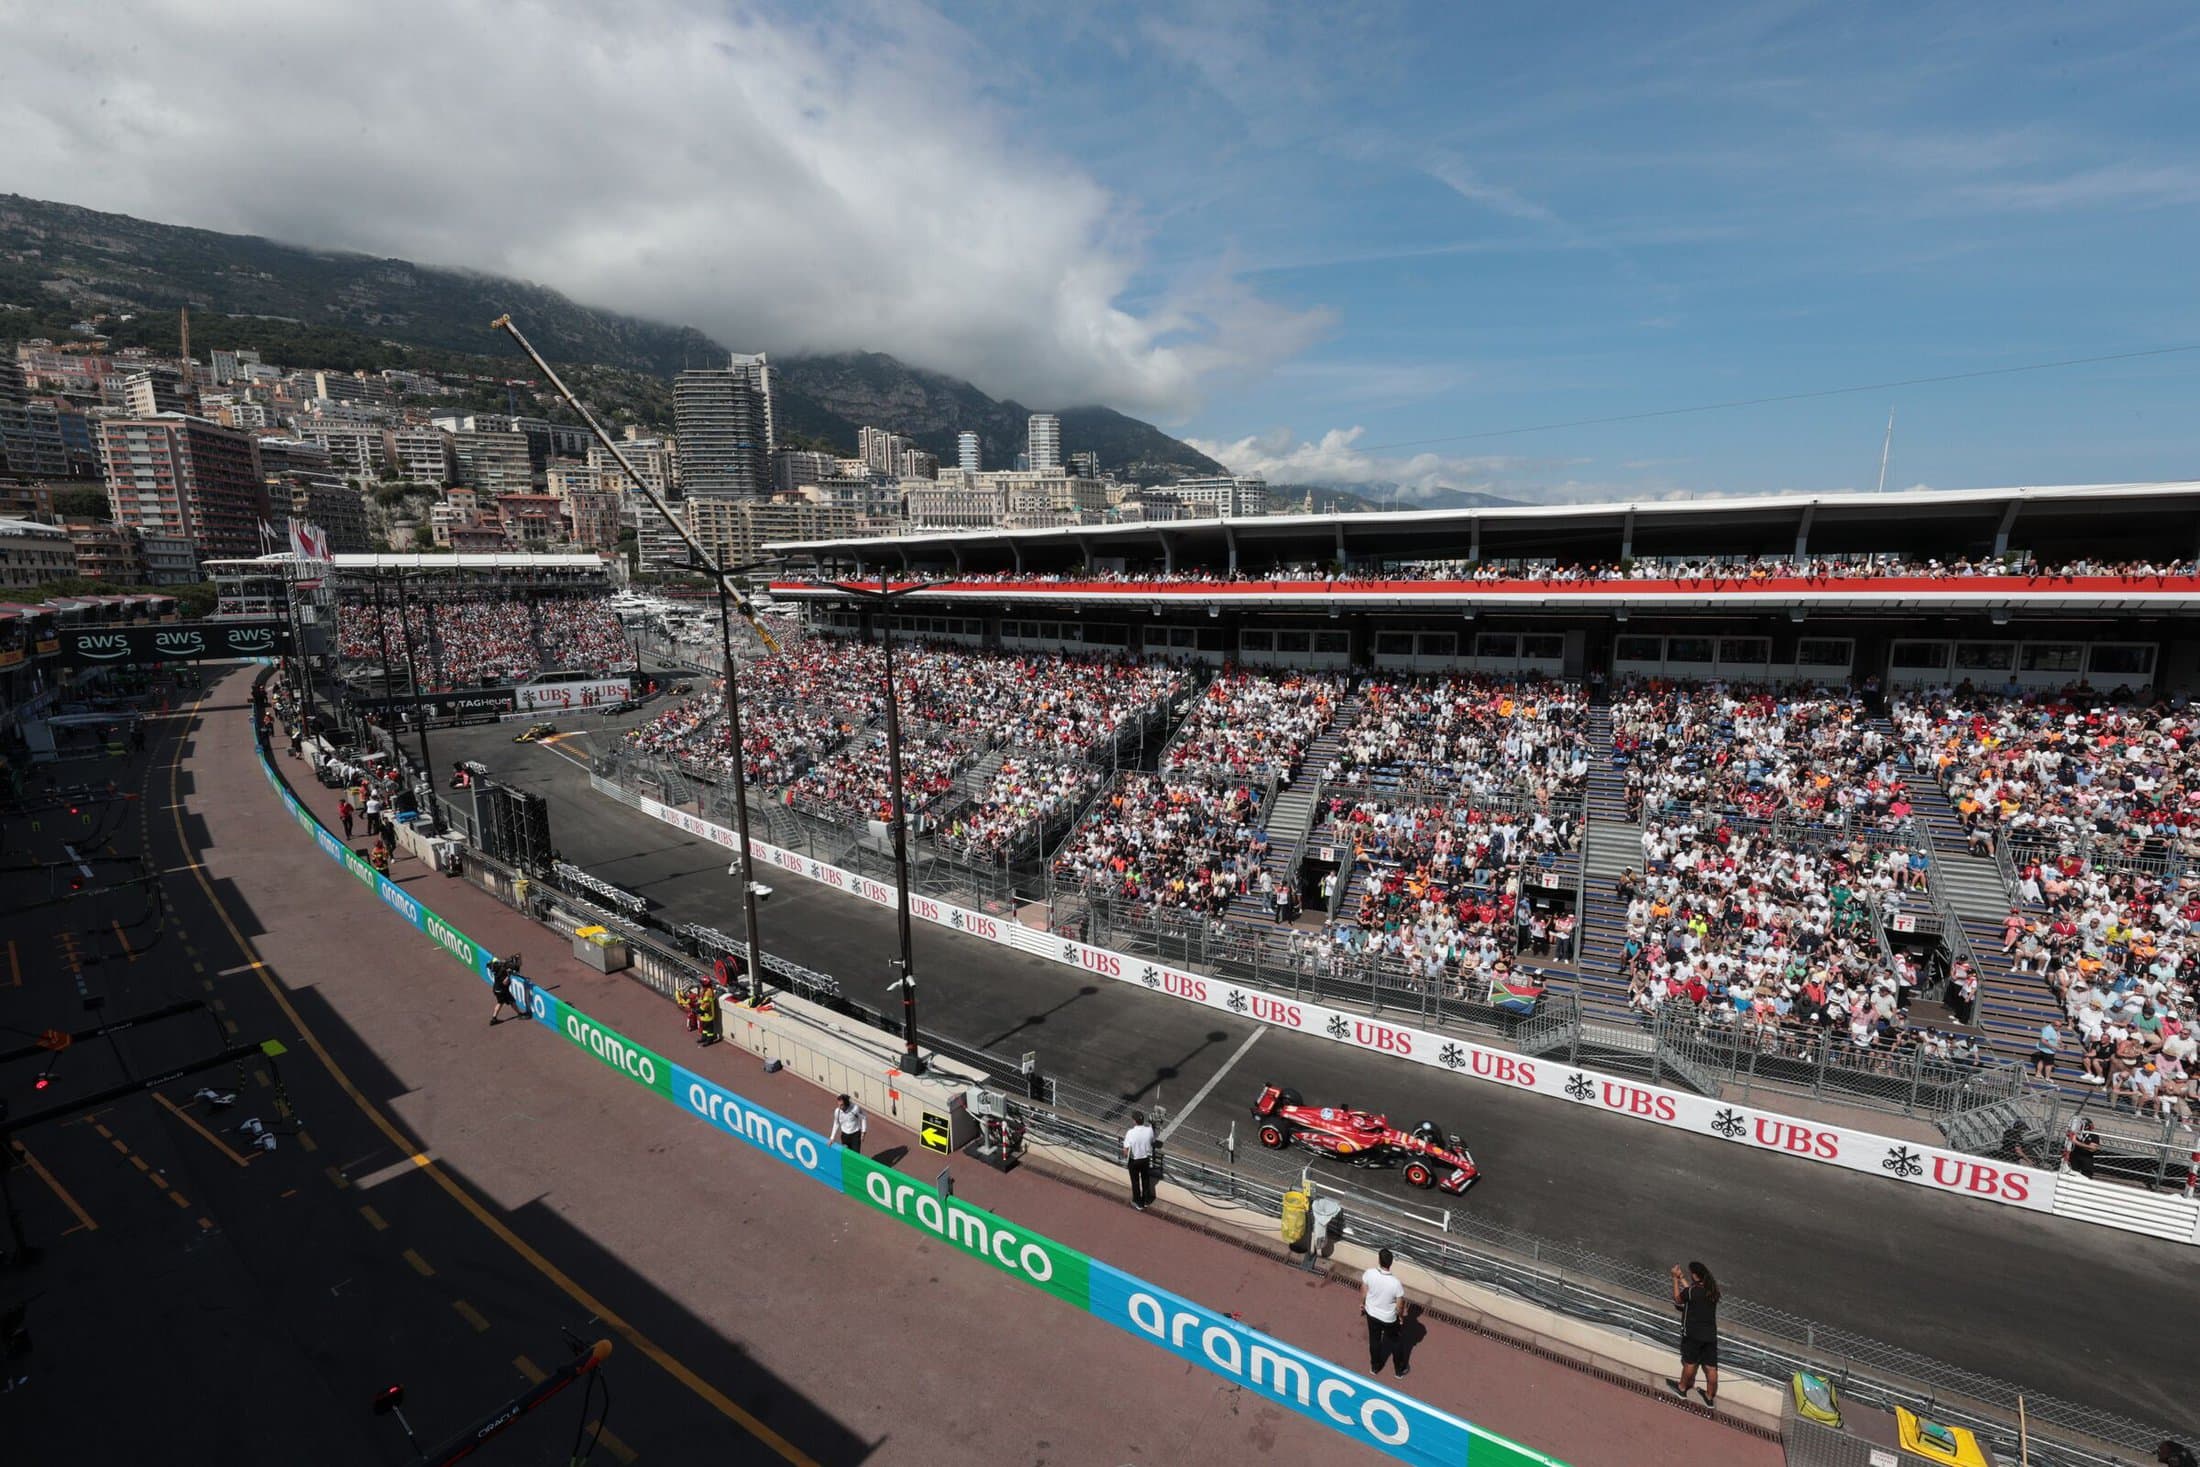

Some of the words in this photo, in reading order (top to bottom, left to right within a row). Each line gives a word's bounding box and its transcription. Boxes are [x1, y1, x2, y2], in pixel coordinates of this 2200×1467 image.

[77, 633, 128, 649] aws
[156, 630, 203, 645] aws
[228, 627, 272, 642] aws
[538, 687, 571, 703] UBS
[596, 684, 625, 697] UBS
[690, 817, 705, 835] UBS
[716, 828, 734, 847] UBS
[345, 854, 374, 888] aramco
[784, 853, 803, 873] UBS
[821, 866, 844, 887] UBS
[382, 882, 417, 923] aramco
[862, 881, 888, 904] UBS
[911, 898, 939, 921] UBS
[427, 917, 472, 966] aramco
[966, 914, 997, 939] UBS
[1081, 948, 1121, 976] UBS
[1163, 970, 1207, 1003] UBS
[1252, 994, 1303, 1029] UBS
[566, 1014, 656, 1086] aramco
[1355, 1020, 1413, 1056] UBS
[1471, 1049, 1537, 1087] UBS
[1602, 1080, 1677, 1121] UBS
[688, 1083, 818, 1171] aramco
[1754, 1116, 1840, 1160] UBS
[1932, 1155, 2030, 1203] UBS
[866, 1171, 1053, 1282] aramco
[1127, 1292, 1410, 1447] aramco
